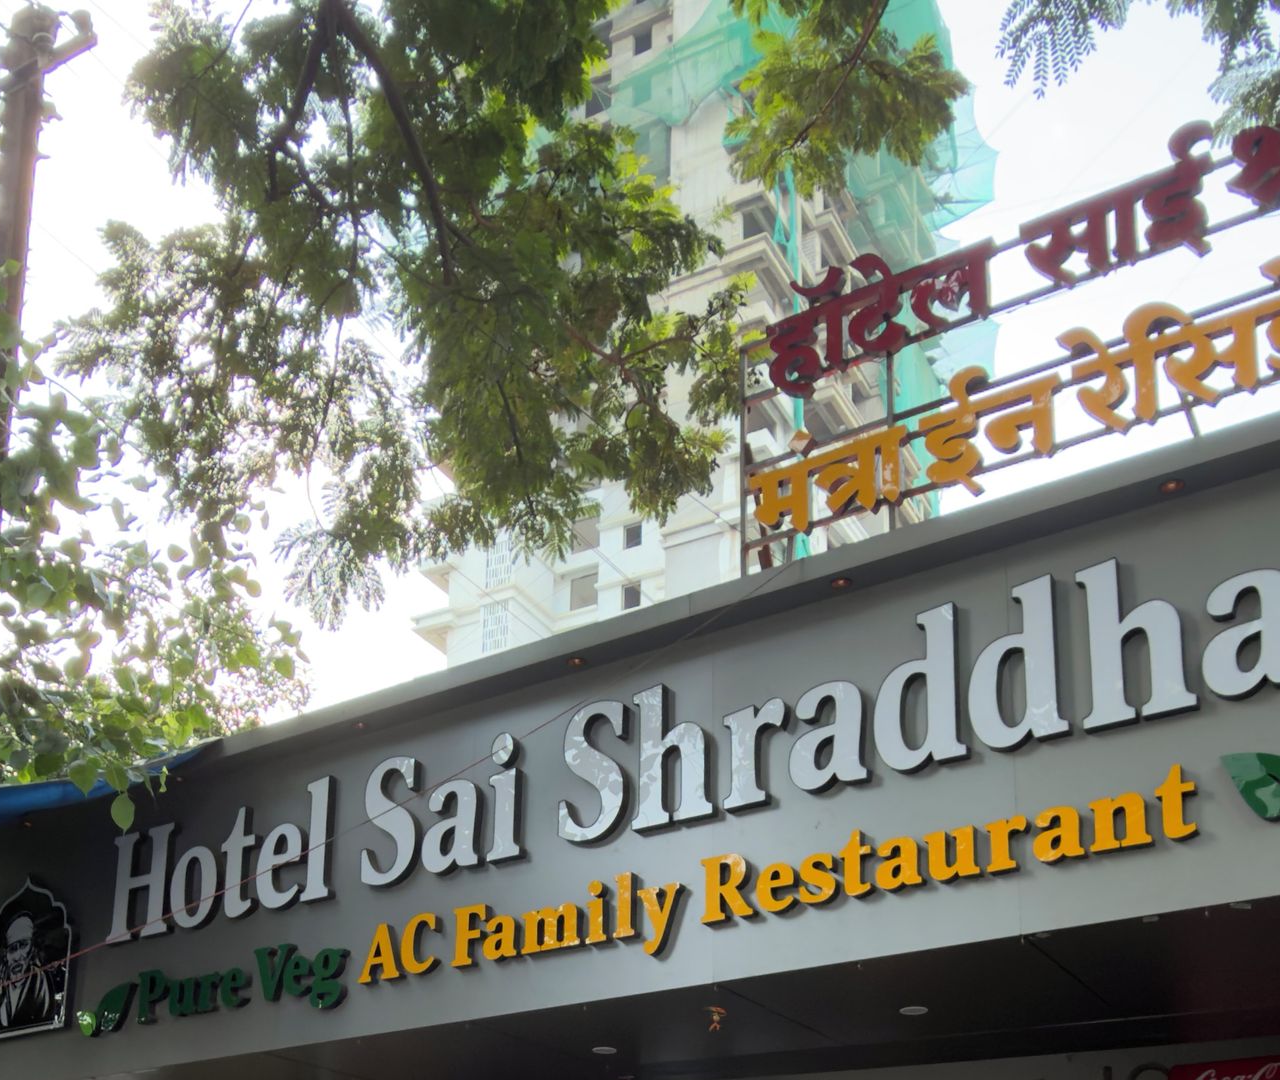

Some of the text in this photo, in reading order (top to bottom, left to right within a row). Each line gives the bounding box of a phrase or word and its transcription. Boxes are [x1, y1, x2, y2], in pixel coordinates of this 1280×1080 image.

[766, 237, 995, 398] हॉटेल
[1019, 119, 1214, 288] साई
[105, 775, 335, 944] Hotel
[360, 733, 526, 887] Sai
[357, 763, 1200, 985] AC Family Restaurant
[136, 943, 350, 1025] Pure Veg
